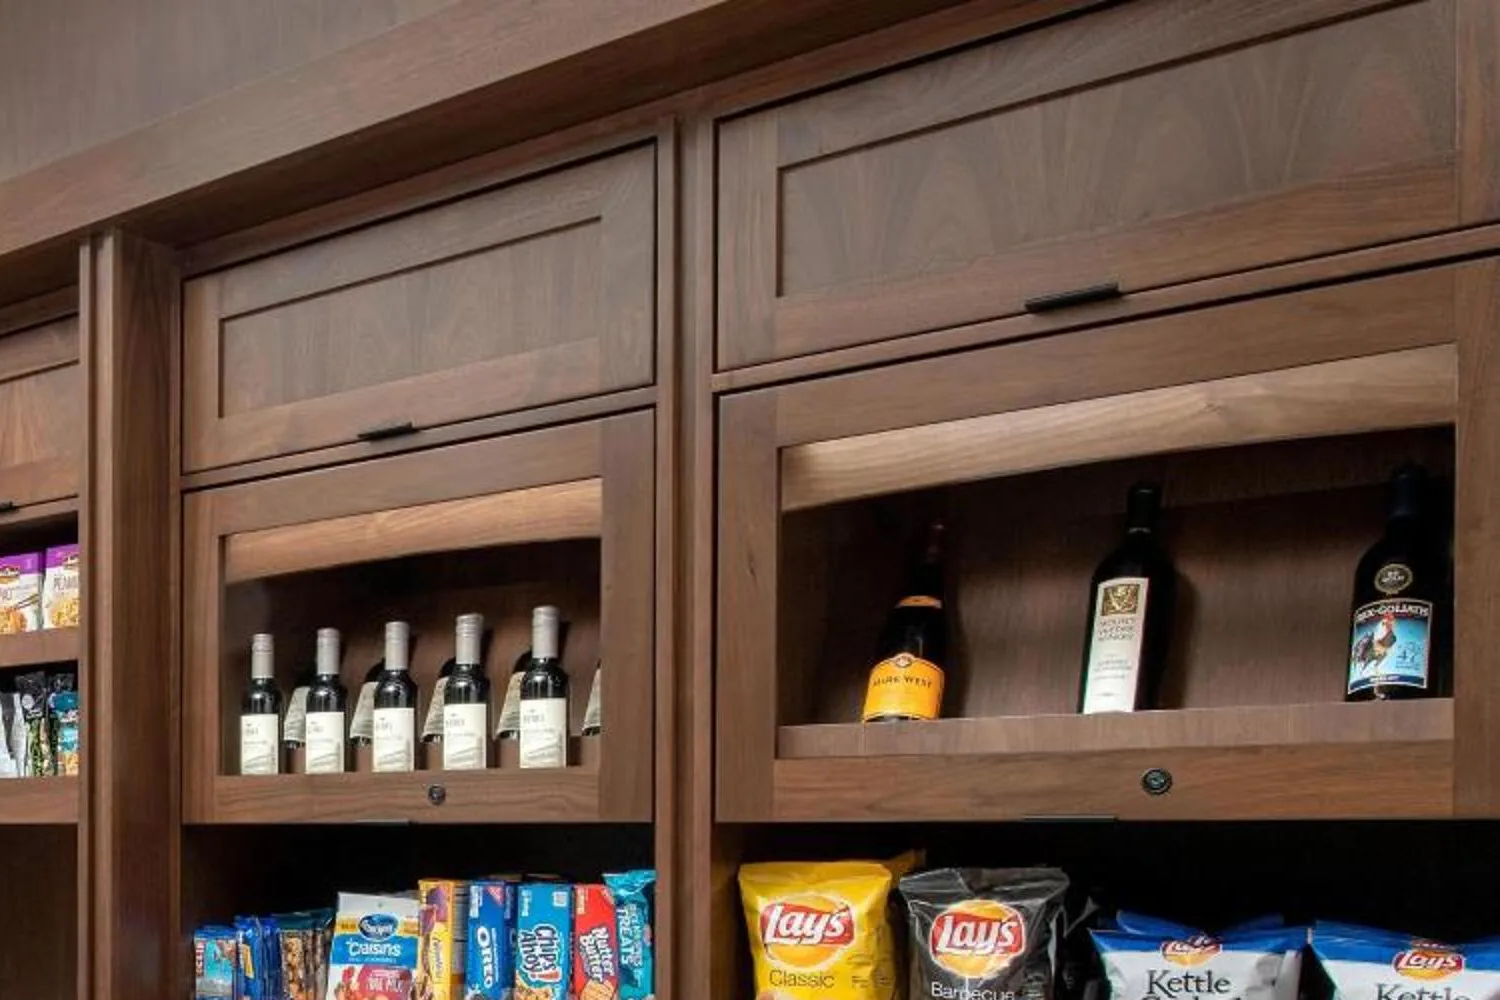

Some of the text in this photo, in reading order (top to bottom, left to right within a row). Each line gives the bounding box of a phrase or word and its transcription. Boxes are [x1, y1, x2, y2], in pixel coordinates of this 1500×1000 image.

[477, 926, 493, 988] OREO
[769, 969, 835, 989] Classic
[1146, 969, 1231, 1000] Kettle
